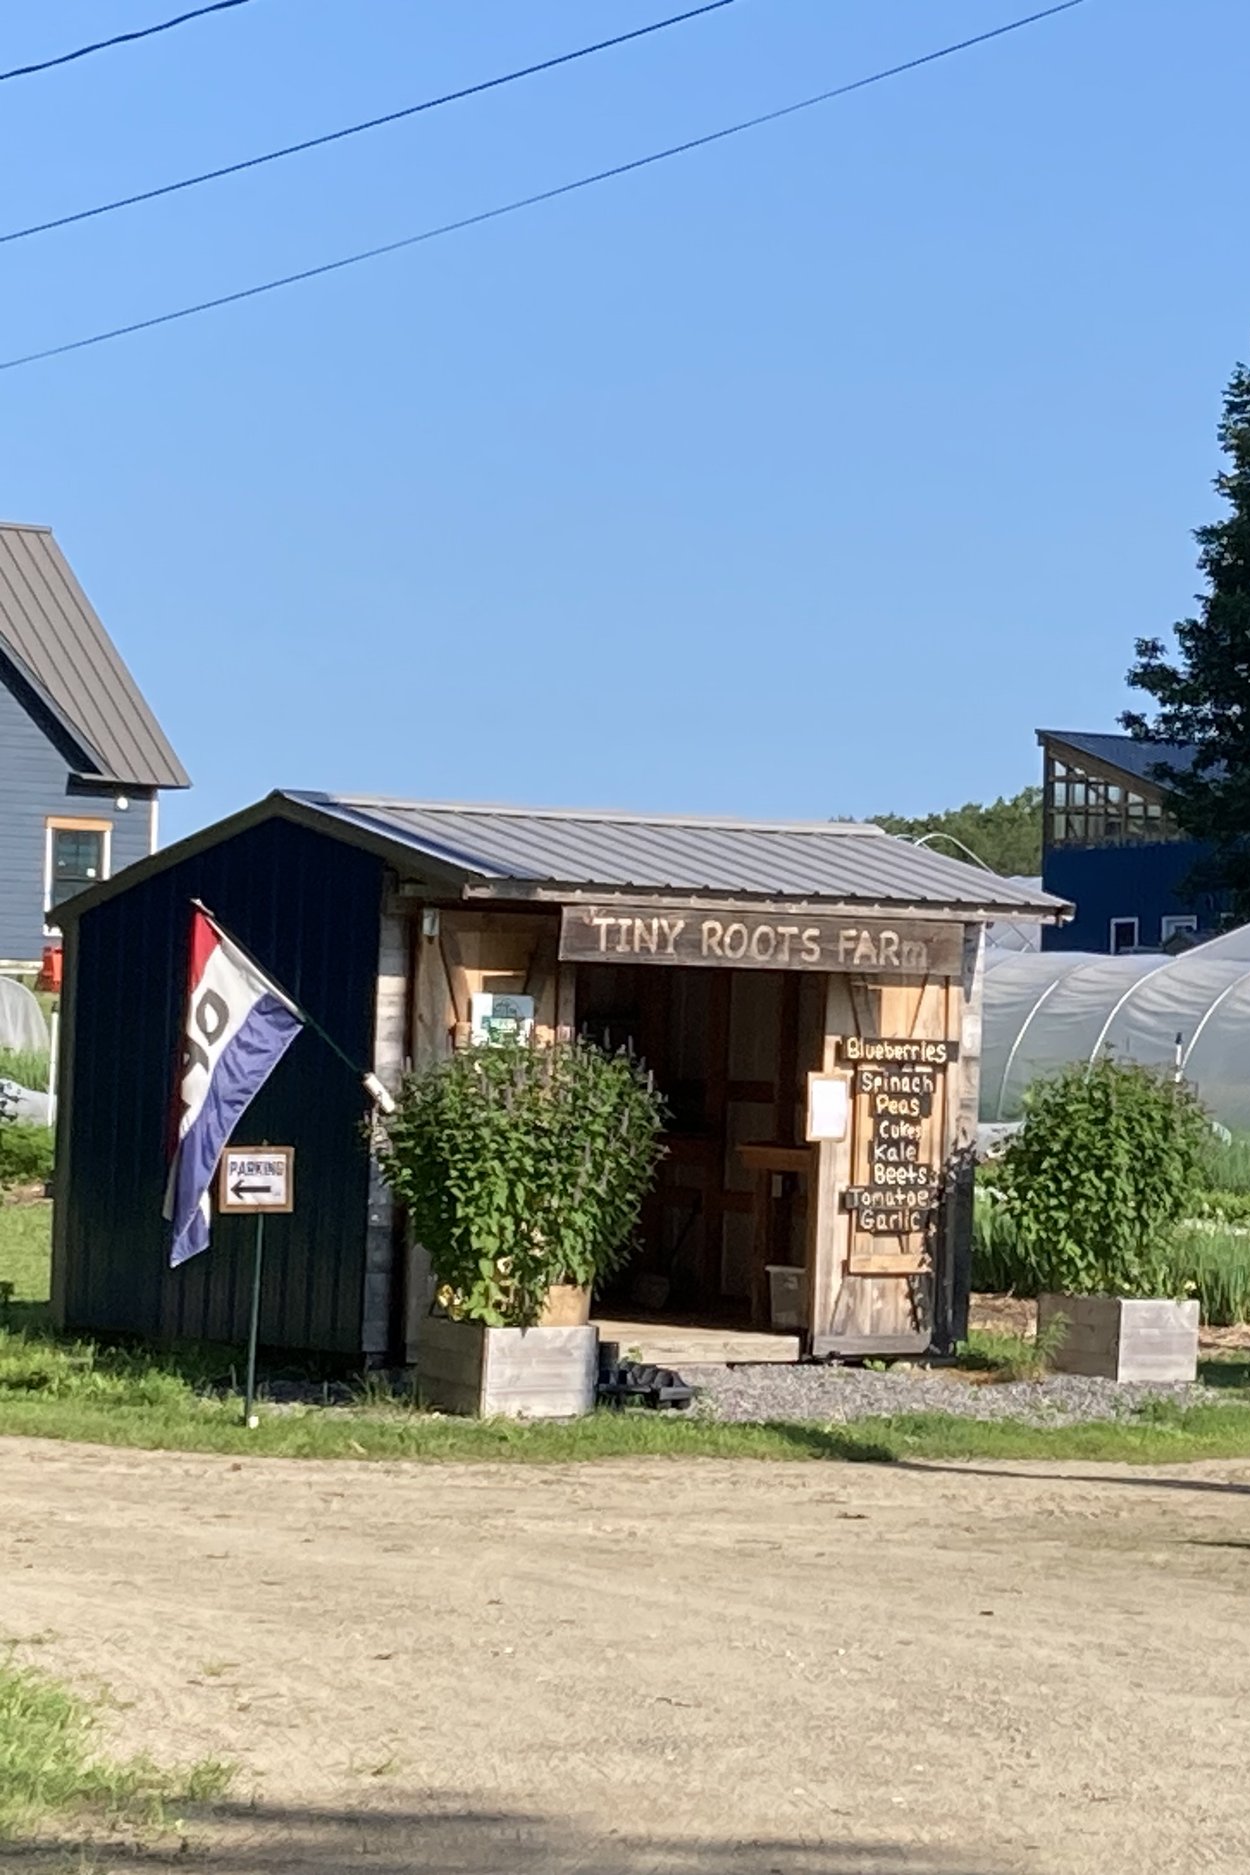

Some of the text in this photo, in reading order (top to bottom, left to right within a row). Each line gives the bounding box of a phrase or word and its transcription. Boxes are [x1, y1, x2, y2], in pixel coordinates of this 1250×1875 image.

[592, 917, 685, 955] TINY
[700, 919, 821, 962] ROOTS
[847, 1036, 947, 1063] Blueberries
[861, 1071, 934, 1094] Spinach
[876, 1093, 920, 1117] Peas
[874, 1139, 917, 1162] Kale
[874, 1162, 928, 1186] Beets
[860, 1208, 921, 1231] Garlic
